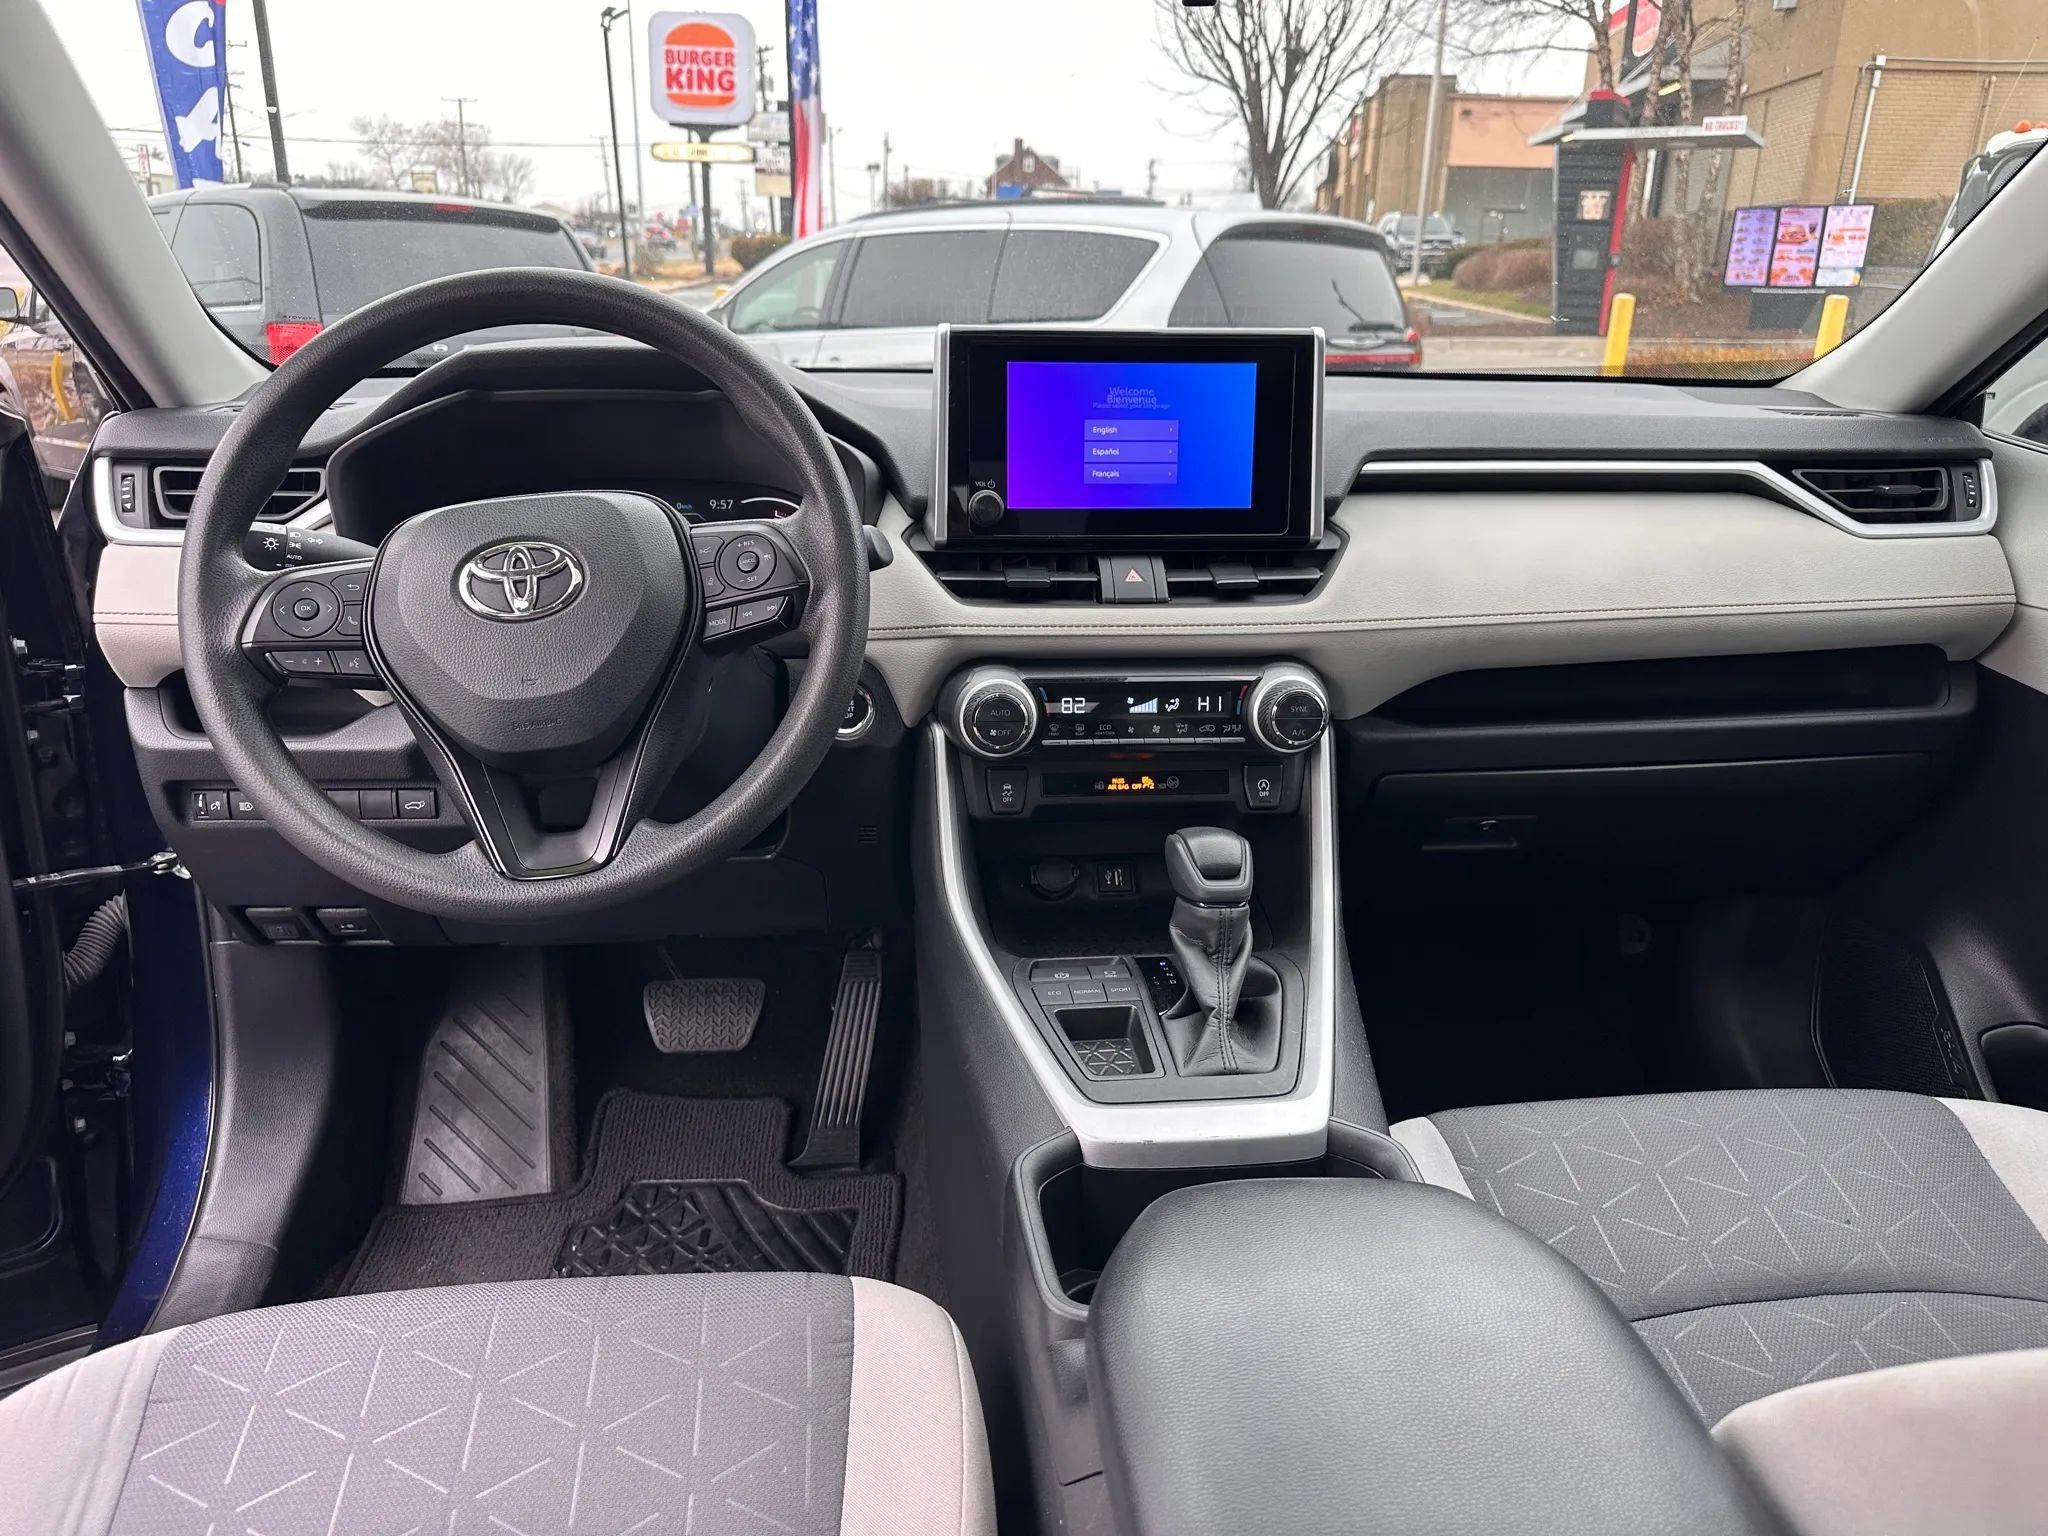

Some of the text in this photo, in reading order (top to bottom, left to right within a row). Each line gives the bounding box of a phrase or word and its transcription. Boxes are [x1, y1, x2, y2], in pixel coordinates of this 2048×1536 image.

[665, 49, 735, 67] BURGER
[666, 68, 735, 91] KING
[1109, 386, 1155, 396] Welcome
[1107, 394, 1158, 405] Bienvenue
[1092, 425, 1118, 435] English
[1092, 447, 1120, 457] Español
[1092, 469, 1120, 479] Français
[709, 499, 734, 510] 9:57
[286, 553, 303, 561] AUTO
[708, 617, 727, 627] MODE
[1061, 697, 1086, 714] 82
[1197, 695, 1223, 712] HI
[990, 707, 1011, 717] AUTO
[1290, 705, 1310, 713] SYNC
[997, 729, 1011, 737] OFF
[1292, 729, 1306, 737] A/C
